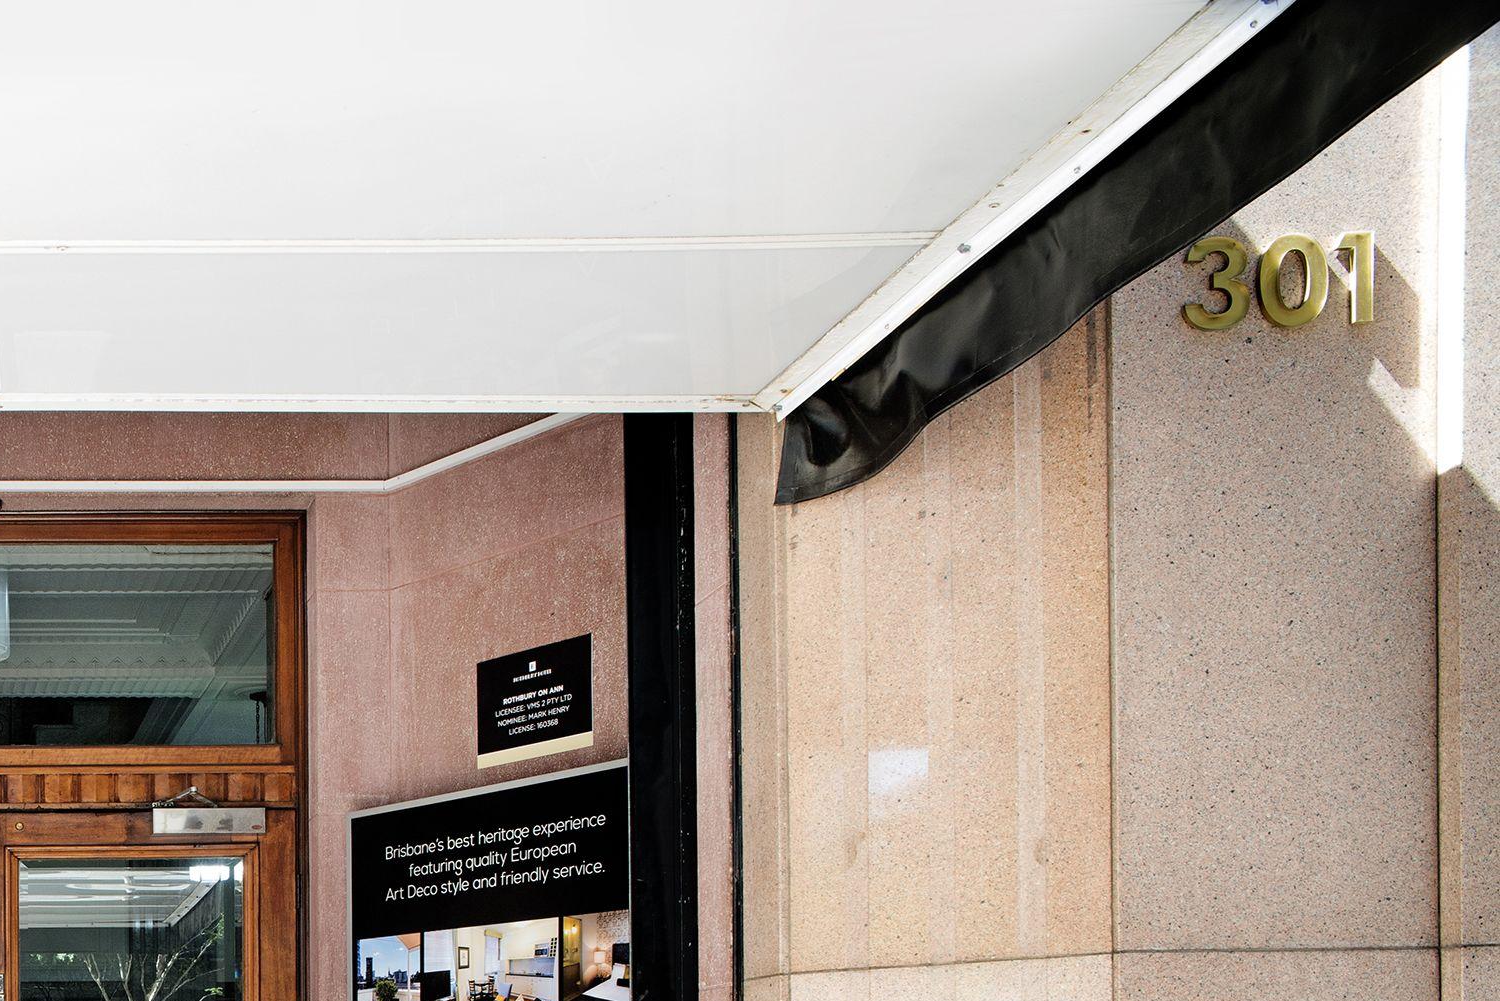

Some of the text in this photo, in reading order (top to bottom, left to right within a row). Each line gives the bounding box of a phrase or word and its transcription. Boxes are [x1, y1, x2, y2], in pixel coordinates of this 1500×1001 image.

[1181, 230, 1376, 331] 301
[495, 705, 525, 717] LICENSEE:
[527, 701, 540, 710] VMS
[547, 697, 559, 705] PTY
[560, 694, 572, 702] LTD
[503, 691, 537, 705] ROTHBURY
[549, 685, 564, 694] ANN
[498, 705, 570, 727] NOMINEE: MARK HENRY
[509, 724, 536, 735] LICENSE:
[385, 814, 606, 860] Brisbane's best heritage experience
[409, 842, 576, 877] featuring quality European
[386, 861, 605, 901] Art Deco style and friendly service.
